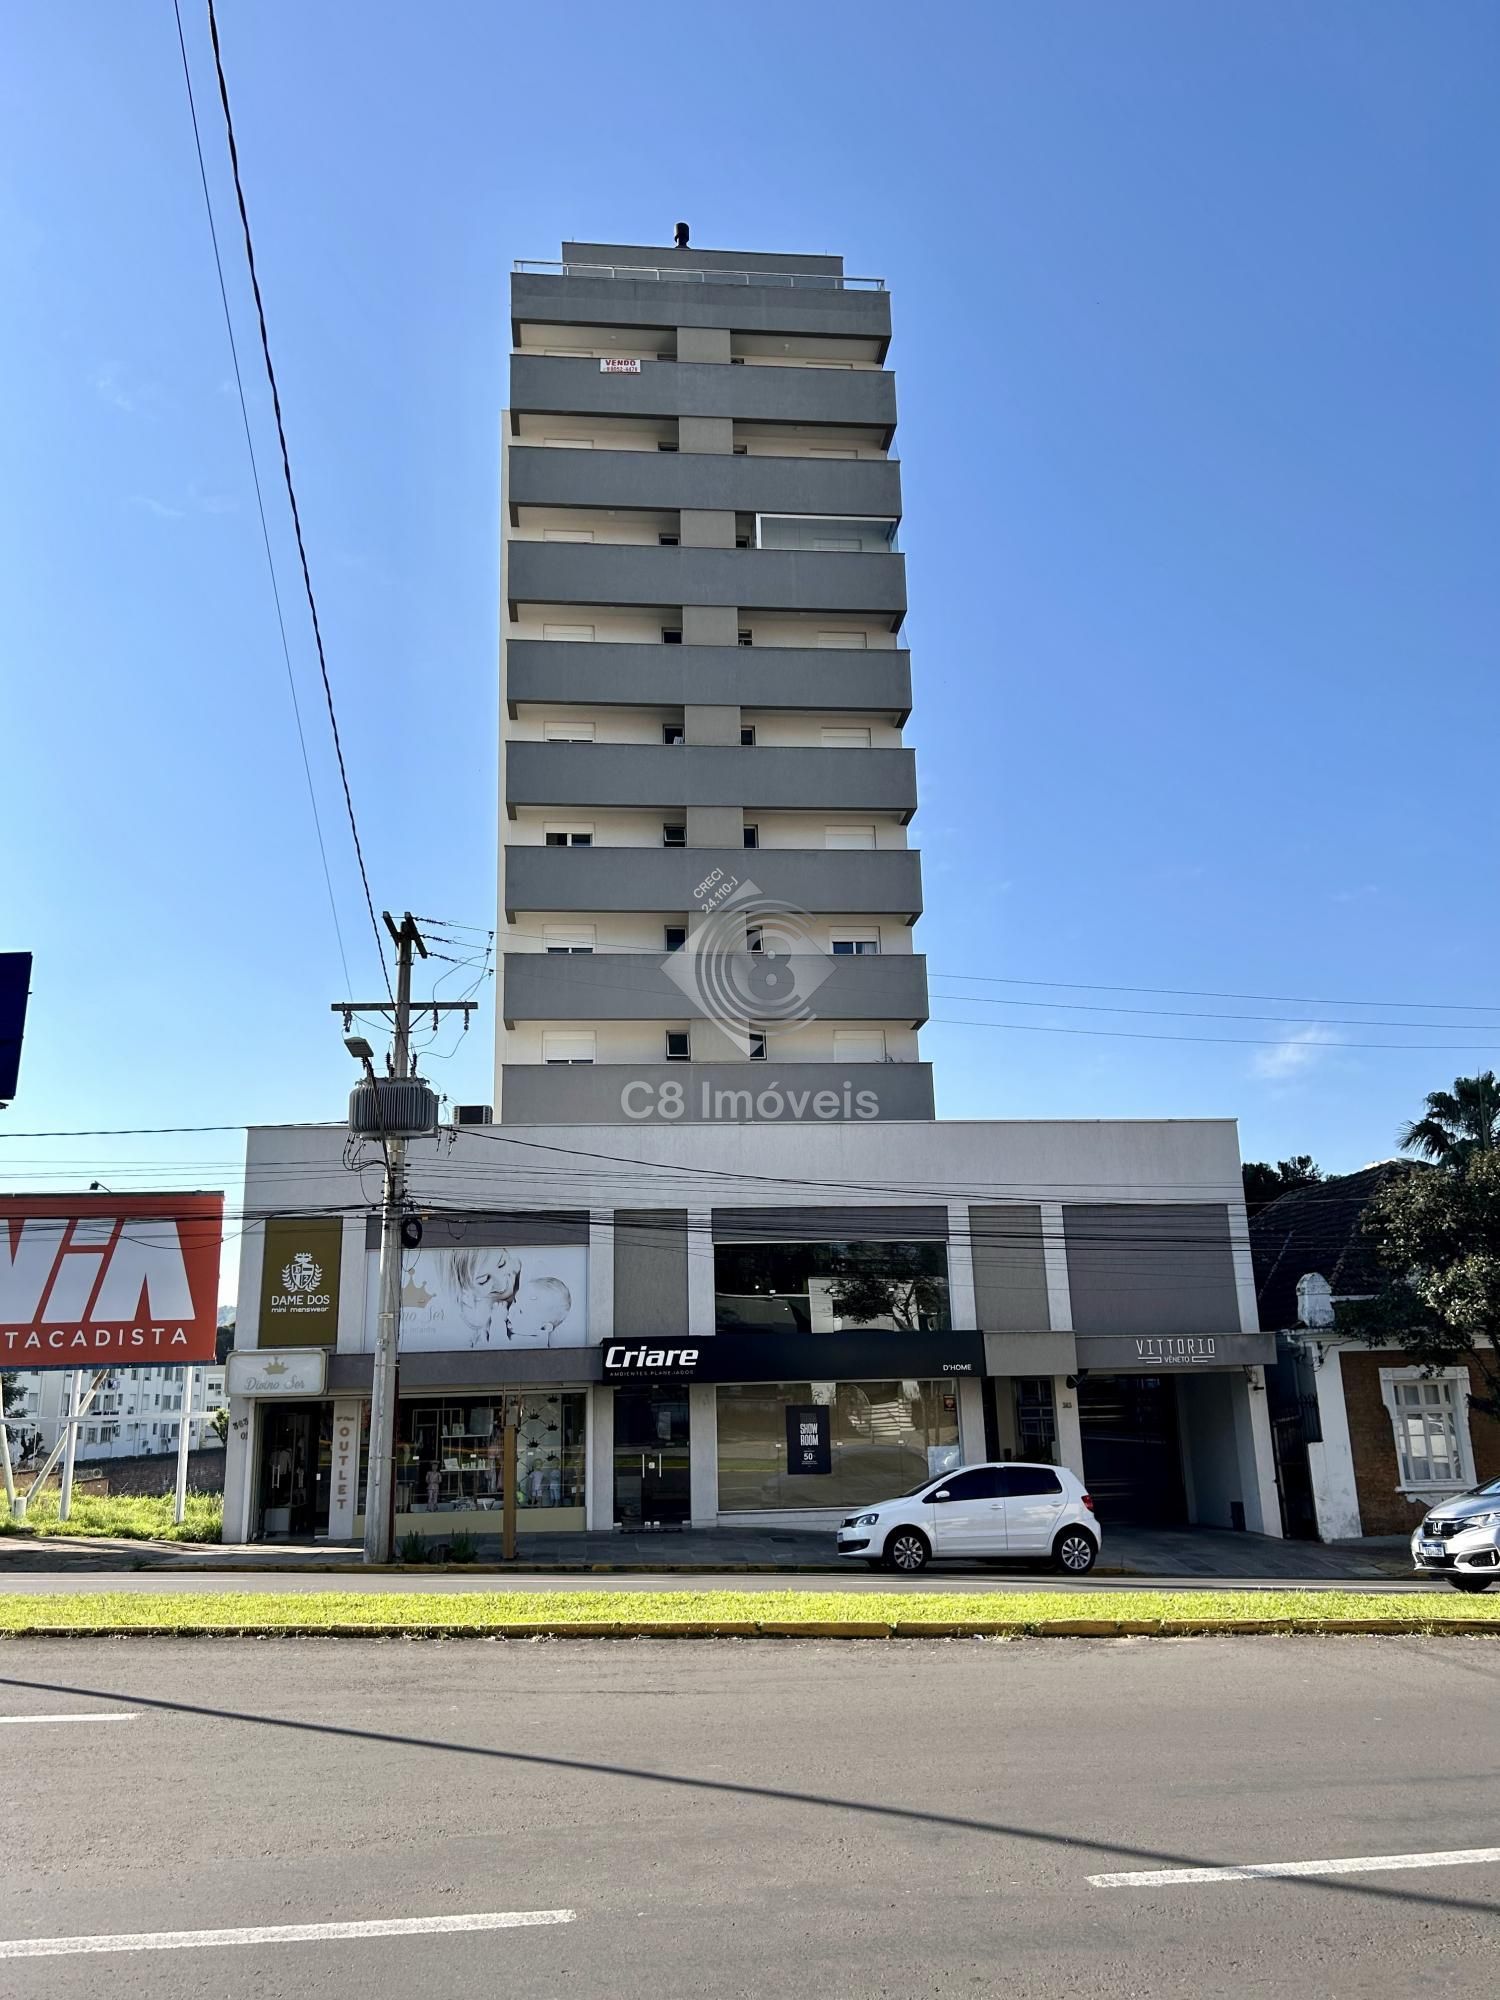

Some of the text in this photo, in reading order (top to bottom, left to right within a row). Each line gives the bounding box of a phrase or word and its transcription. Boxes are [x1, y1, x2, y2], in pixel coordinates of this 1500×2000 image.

[605, 359, 636, 367] VENDO
[271, 1294, 330, 1306] DAME DOS
[1135, 1338, 1216, 1355] VITTORIO
[605, 1345, 700, 1368] Criare
[799, 1423, 818, 1435] SHOW
[800, 1434, 819, 1446] ROOM
[336, 1426, 350, 1510] OUTLET
